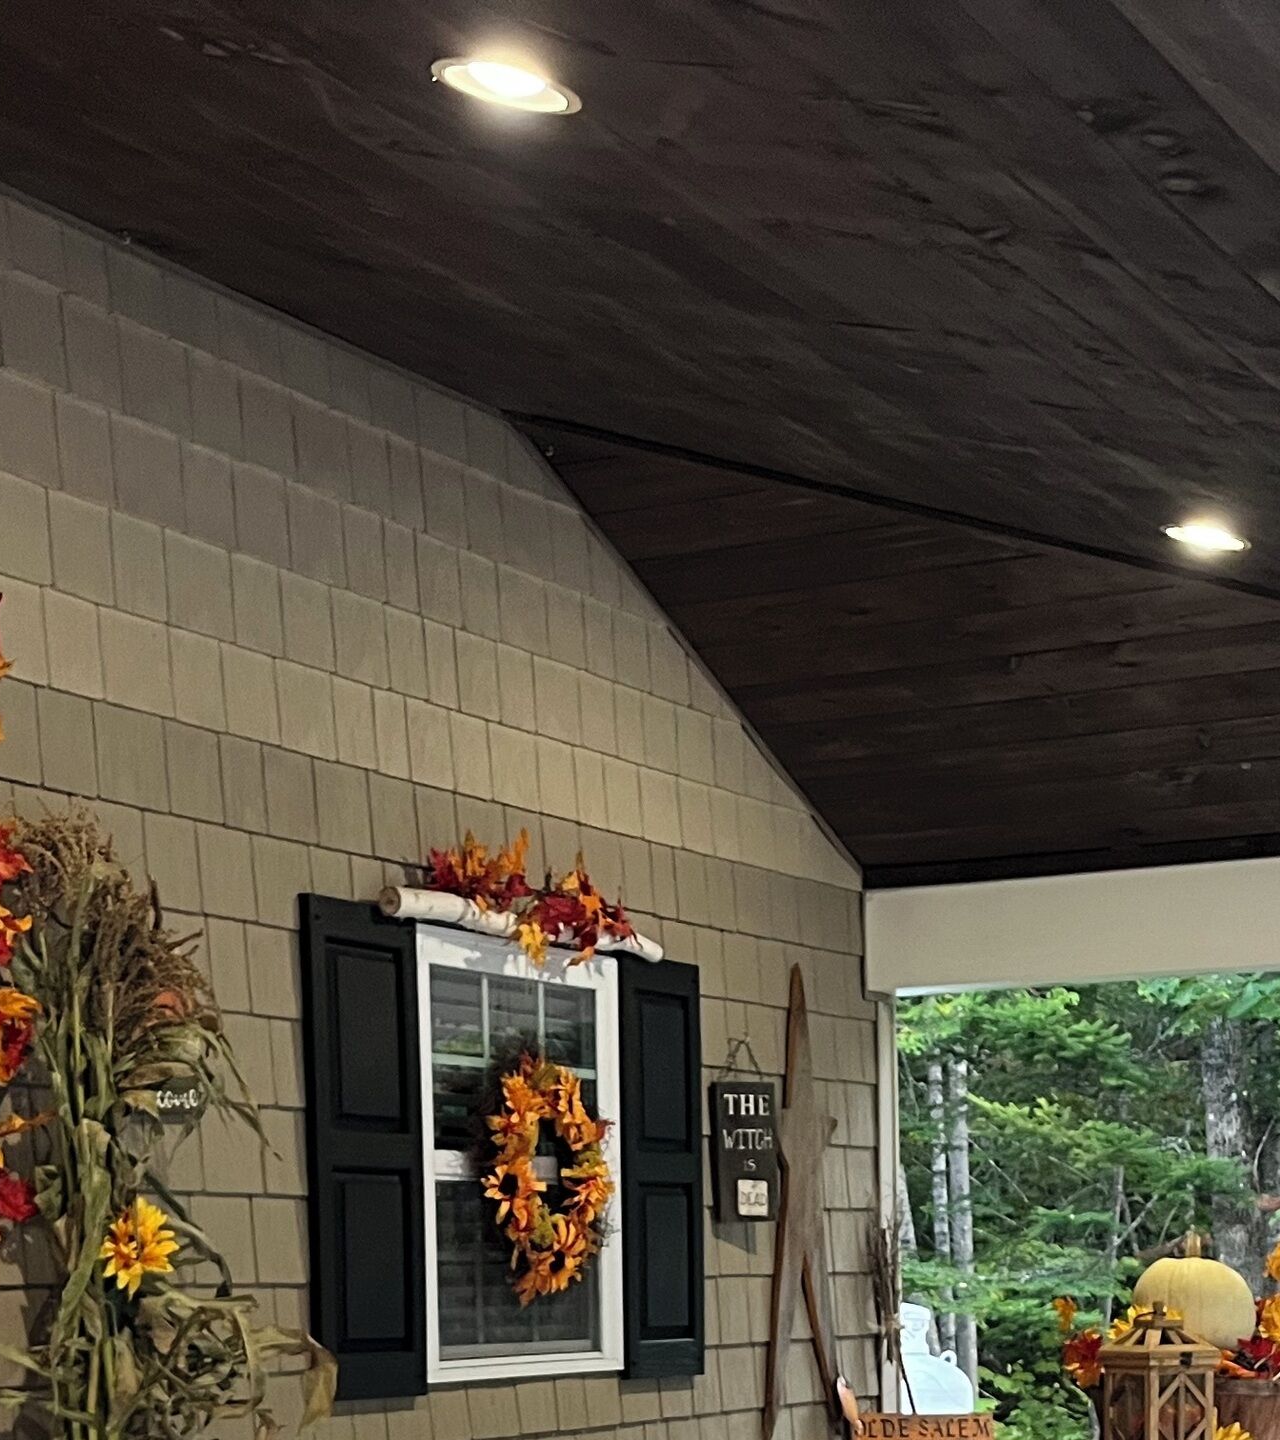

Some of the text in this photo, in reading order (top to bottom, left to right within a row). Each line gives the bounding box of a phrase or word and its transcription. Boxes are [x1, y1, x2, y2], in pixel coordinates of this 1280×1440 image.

[723, 1094, 771, 1117] THE
[722, 1127, 774, 1151] WITCH
[918, 1418, 992, 1440] SALEM
